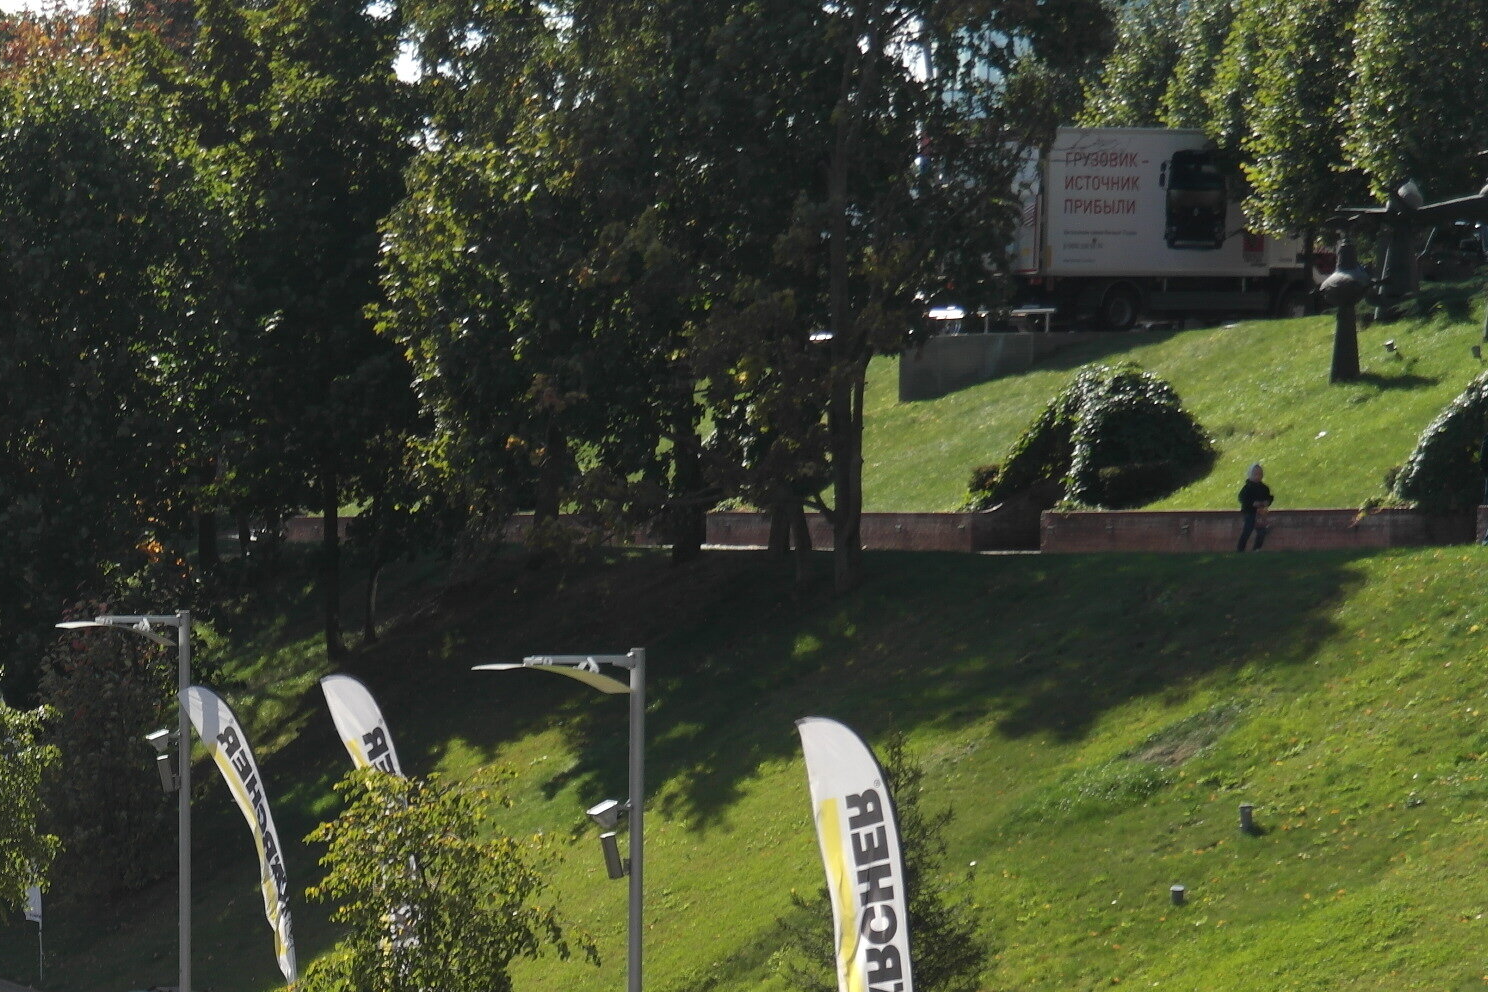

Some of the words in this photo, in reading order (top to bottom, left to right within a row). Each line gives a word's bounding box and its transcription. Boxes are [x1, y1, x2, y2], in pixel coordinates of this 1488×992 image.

[1066, 152, 1139, 167] ГРУЗОВИК
[1065, 176, 1140, 191] ИСТОЧНИК
[1065, 200, 1136, 215] ПРИБЫЛИ
